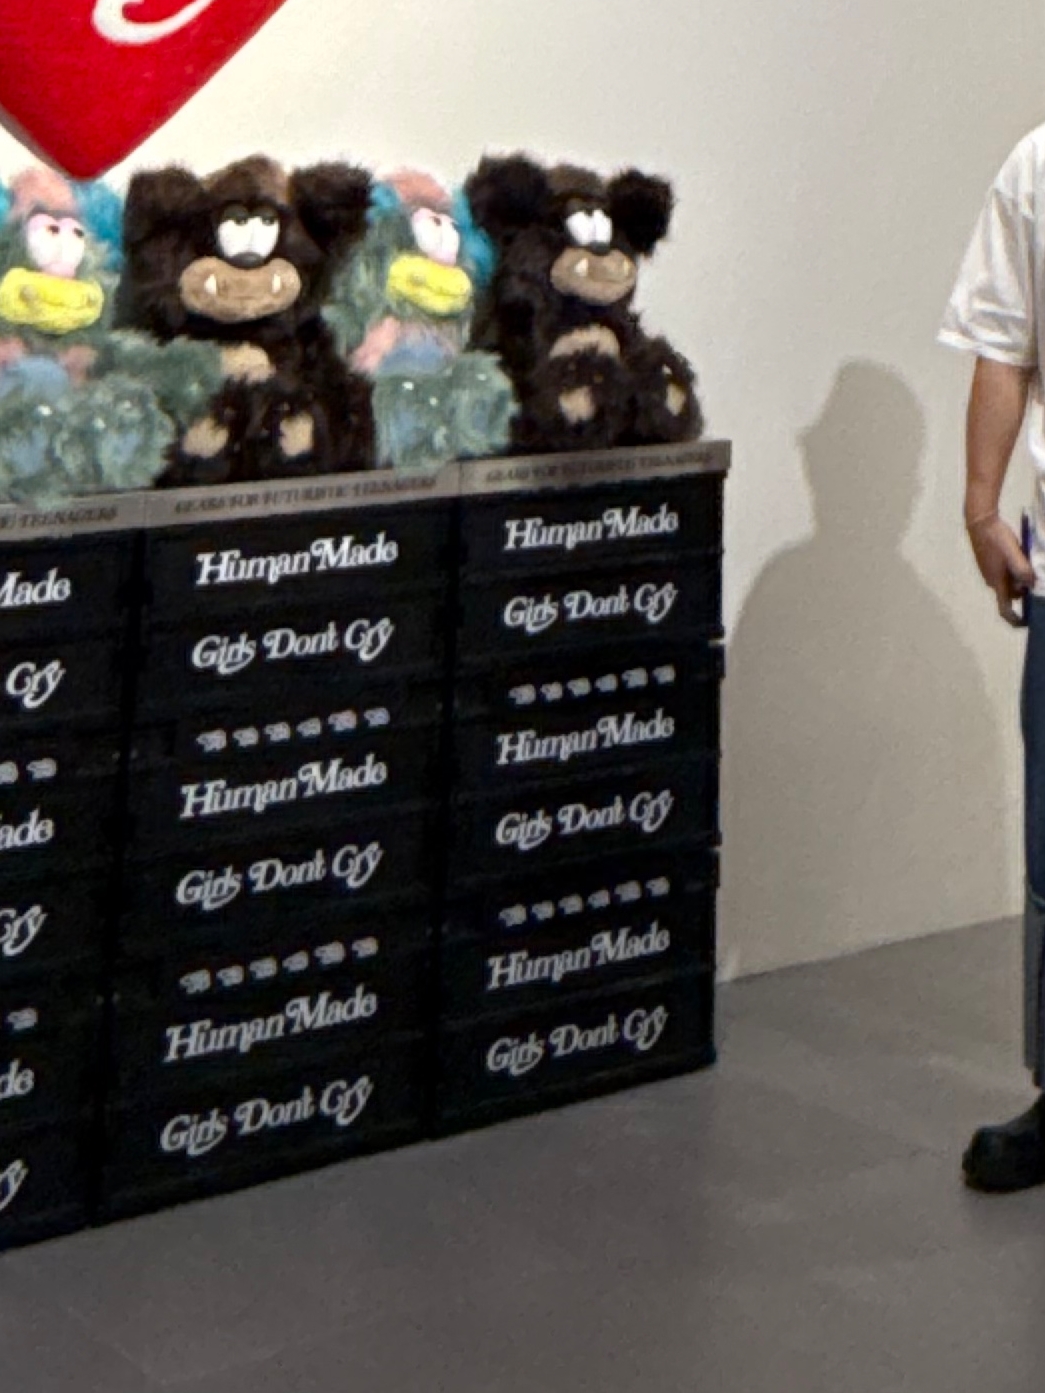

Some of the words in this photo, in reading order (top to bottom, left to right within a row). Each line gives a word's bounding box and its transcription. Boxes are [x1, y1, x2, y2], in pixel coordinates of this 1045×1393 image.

[504, 517, 602, 550] Human
[602, 503, 679, 539] Made
[196, 549, 312, 585] Human
[310, 531, 398, 572] Made
[504, 596, 558, 634] Girls
[634, 582, 678, 624] Cry
[192, 632, 256, 675] Girls
[344, 617, 395, 661] Cry
[5, 659, 67, 709] Cry
[497, 729, 598, 765] Human
[596, 709, 675, 749] Made
[180, 779, 297, 819] Human
[297, 753, 388, 797] Made
[0, 809, 55, 850] ade
[496, 809, 550, 850] Girls
[629, 789, 674, 833] Cry
[176, 865, 243, 911] Girls
[332, 841, 384, 889] Cry
[487, 947, 590, 990] Human
[591, 920, 670, 965] Made
[163, 1014, 286, 1063] Human
[285, 983, 379, 1035] Made
[486, 1033, 544, 1076] Girls
[624, 1005, 669, 1051] Cry
[160, 1108, 229, 1156] Girls
[320, 1075, 374, 1126] Cry
